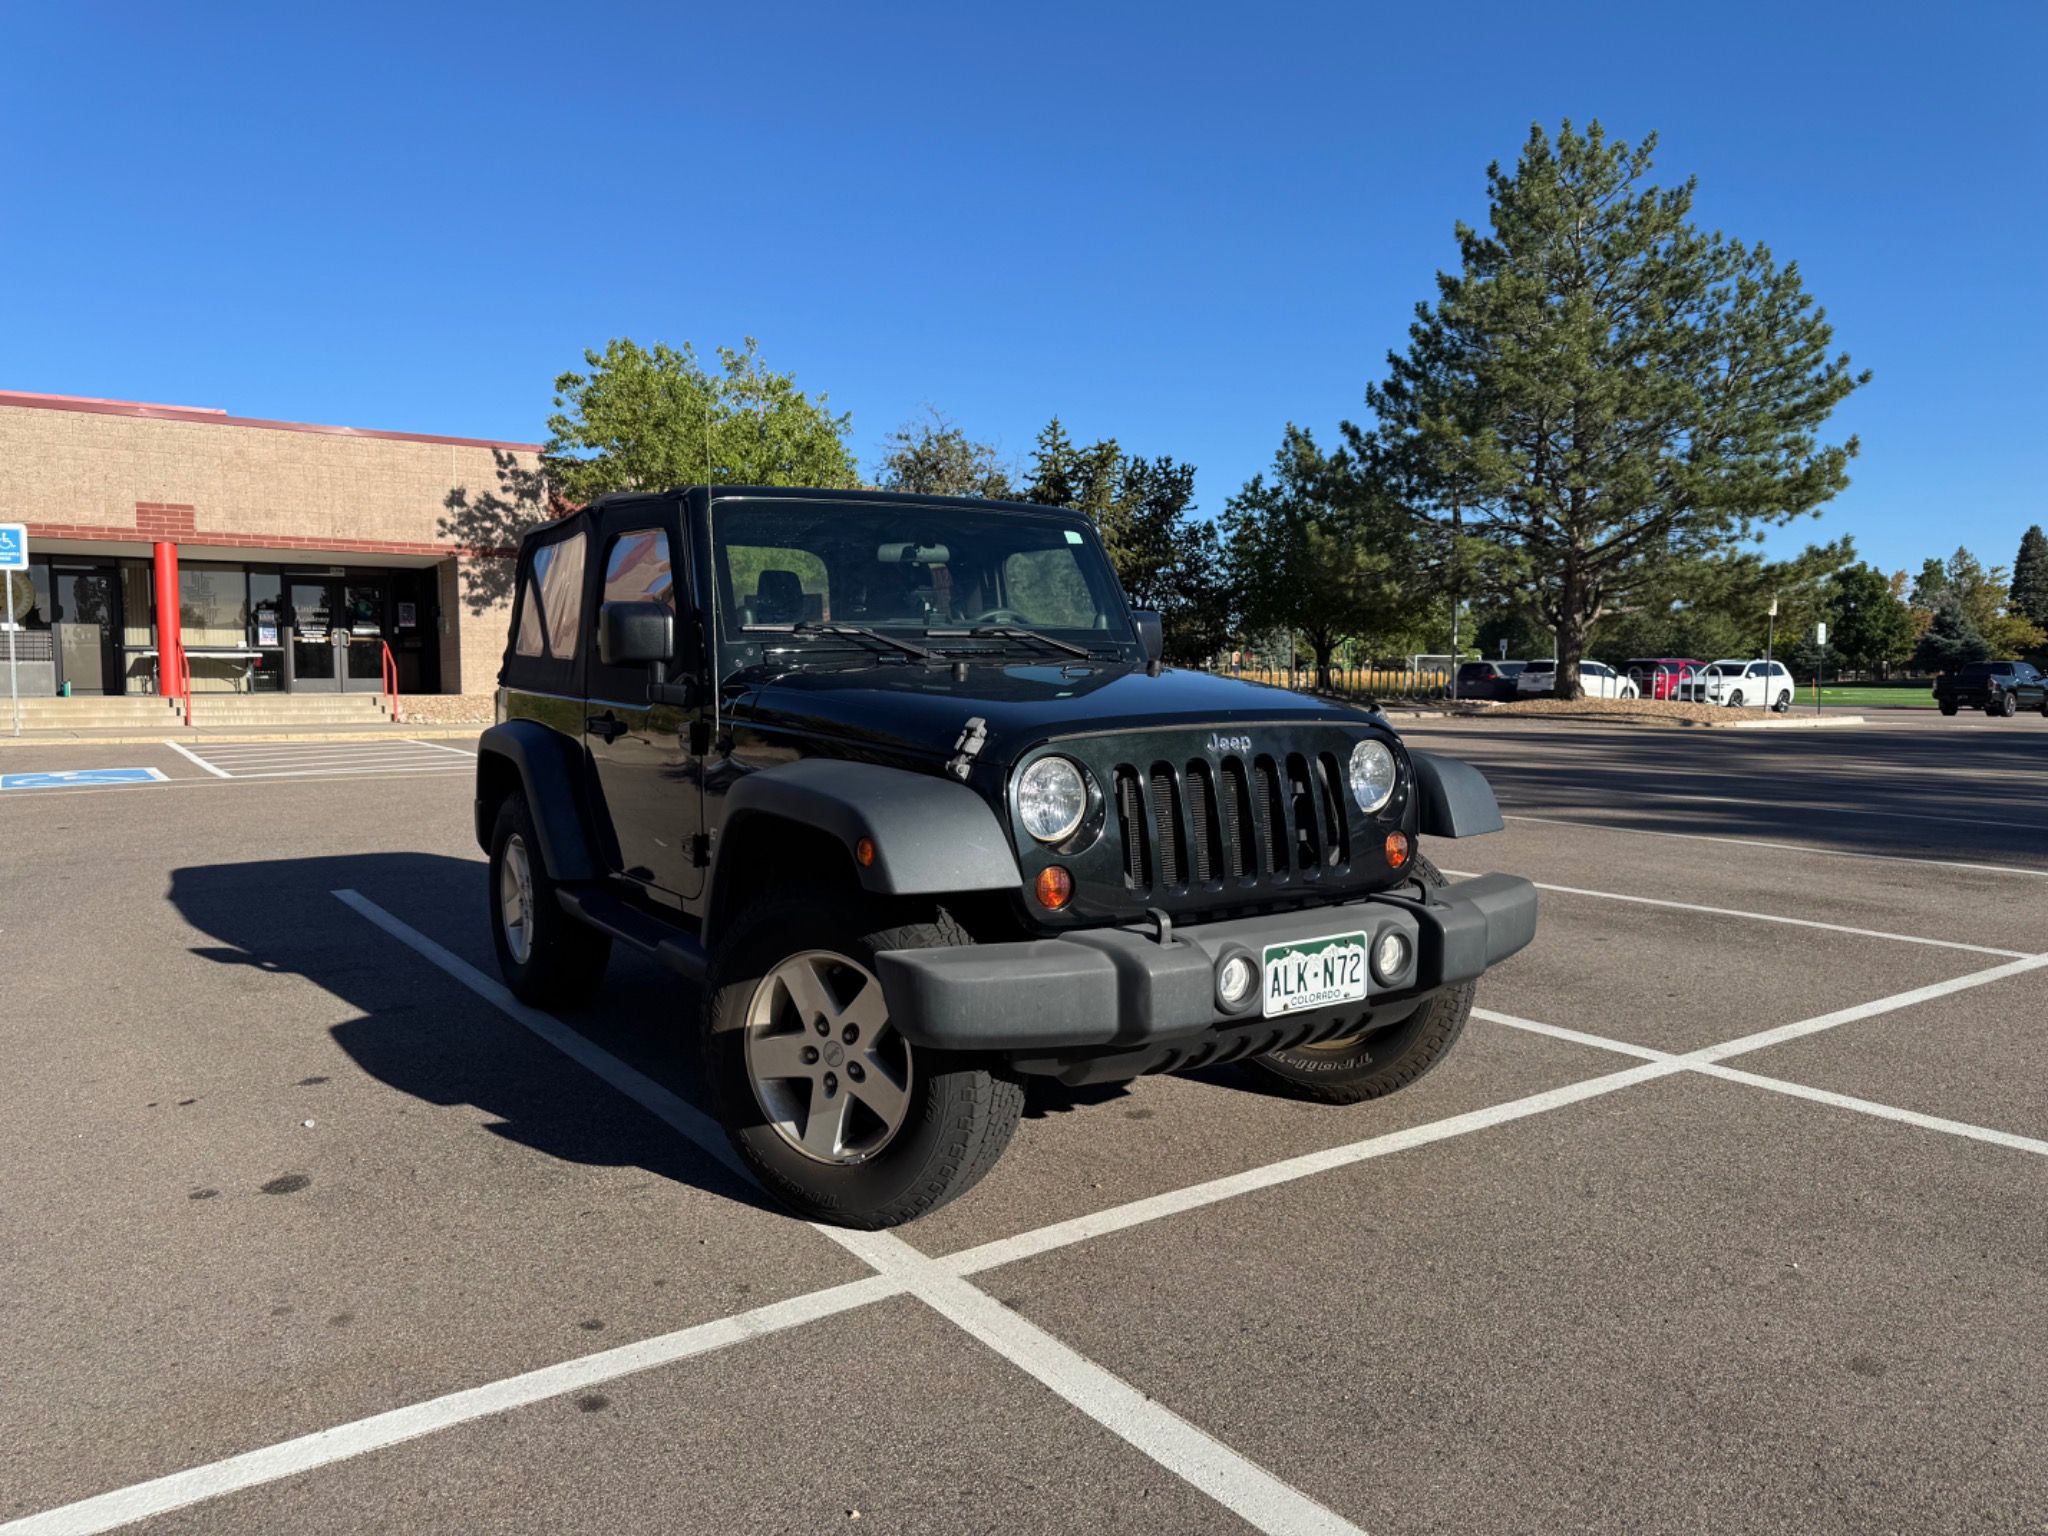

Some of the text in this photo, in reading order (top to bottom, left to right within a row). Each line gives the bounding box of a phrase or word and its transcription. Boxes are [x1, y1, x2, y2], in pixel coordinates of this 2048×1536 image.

[295, 614, 330, 624] Academy
[1206, 732, 1252, 754] Jeep
[1290, 989, 1342, 1006] COLORADO
